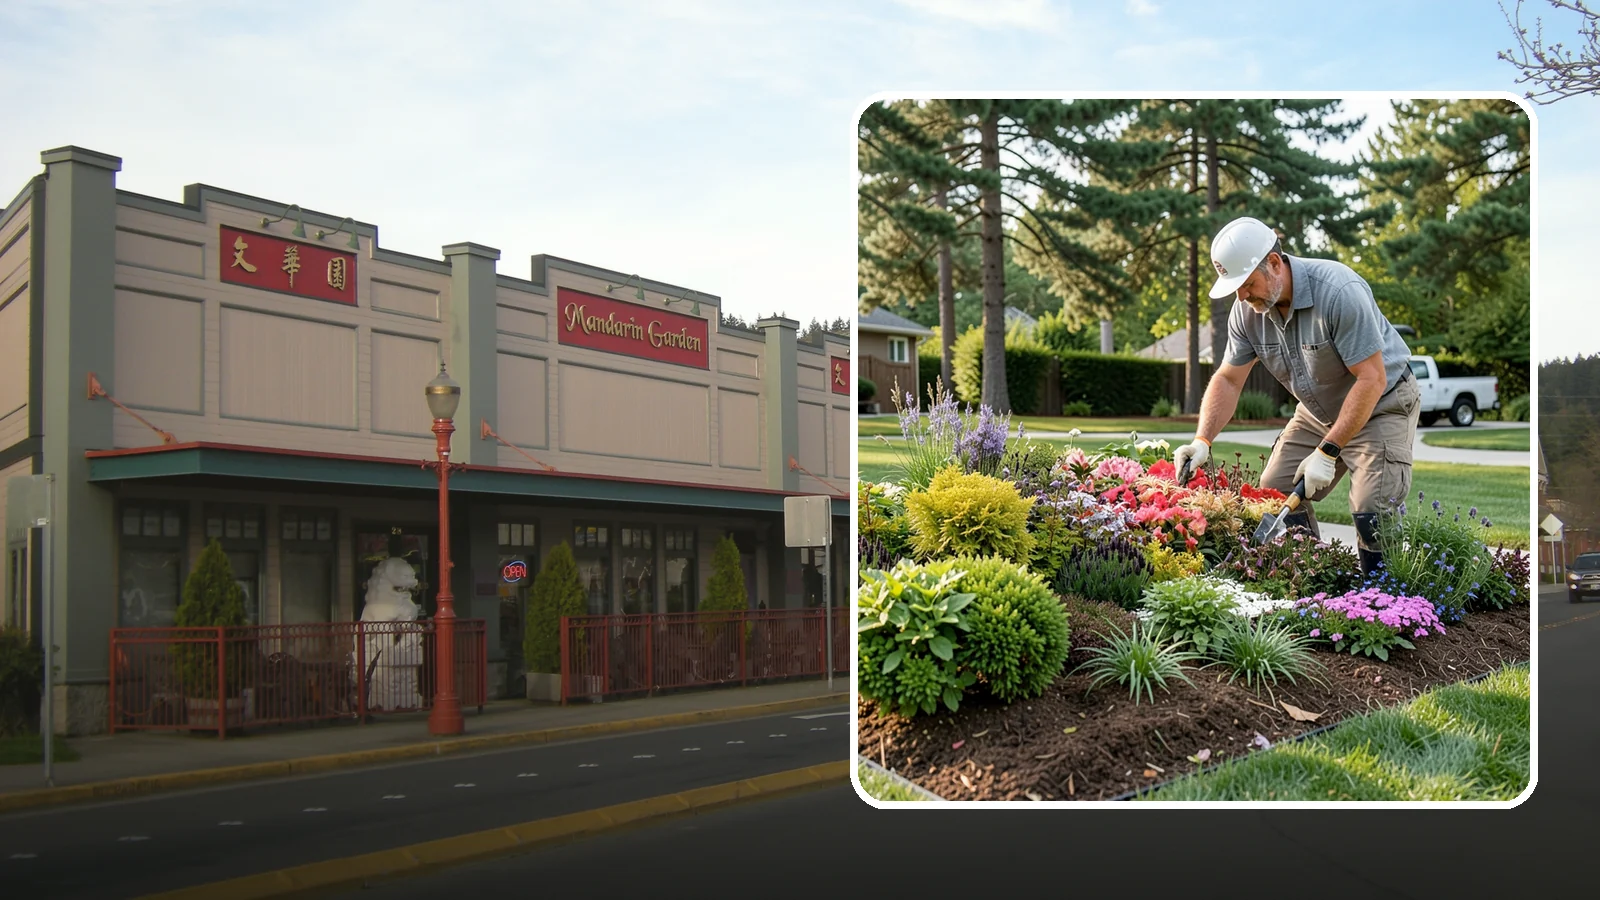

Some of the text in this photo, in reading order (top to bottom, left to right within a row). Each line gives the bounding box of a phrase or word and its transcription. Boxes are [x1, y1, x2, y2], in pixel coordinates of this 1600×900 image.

[230, 235, 346, 291] 文華園
[564, 302, 702, 352] Mandarin Garden
[503, 565, 527, 578] OPEN
